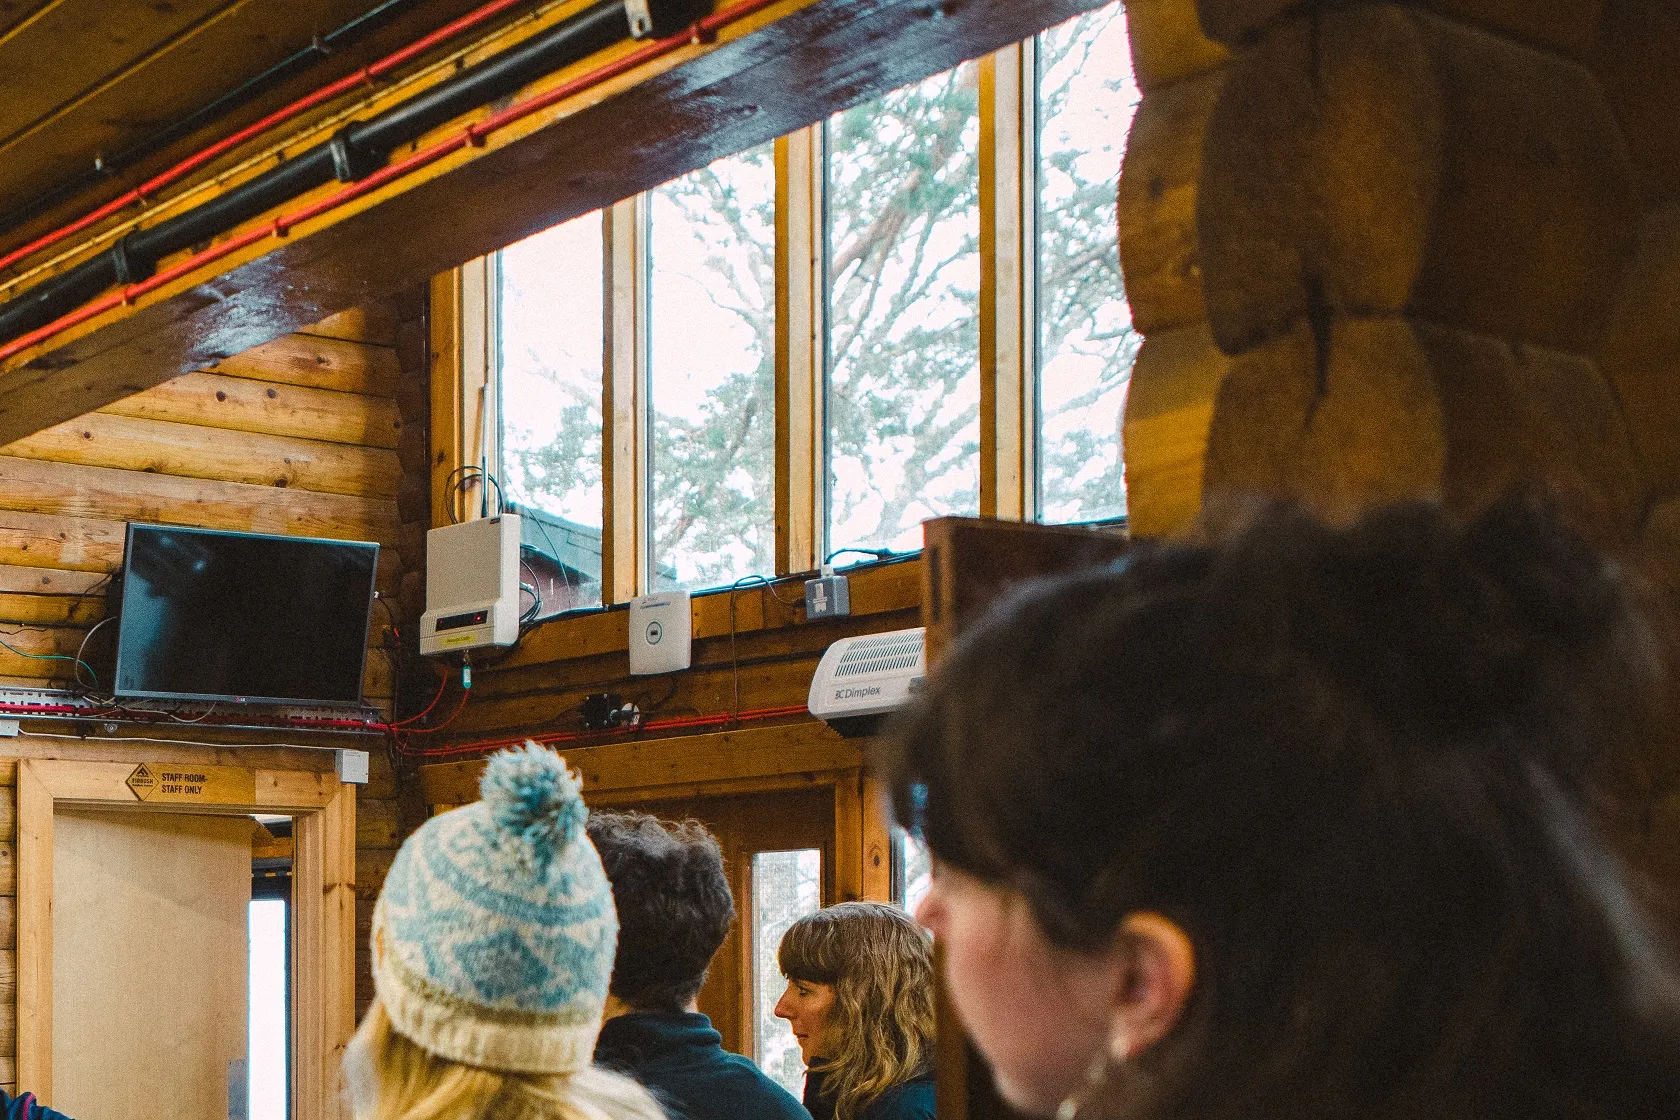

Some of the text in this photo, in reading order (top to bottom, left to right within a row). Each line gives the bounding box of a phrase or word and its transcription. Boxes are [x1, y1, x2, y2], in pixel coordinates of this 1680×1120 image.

[845, 685, 881, 699] Dimplex
[161, 773, 182, 782] STAFF
[161, 785, 182, 793] STAFF
[184, 785, 202, 794] ONLY
